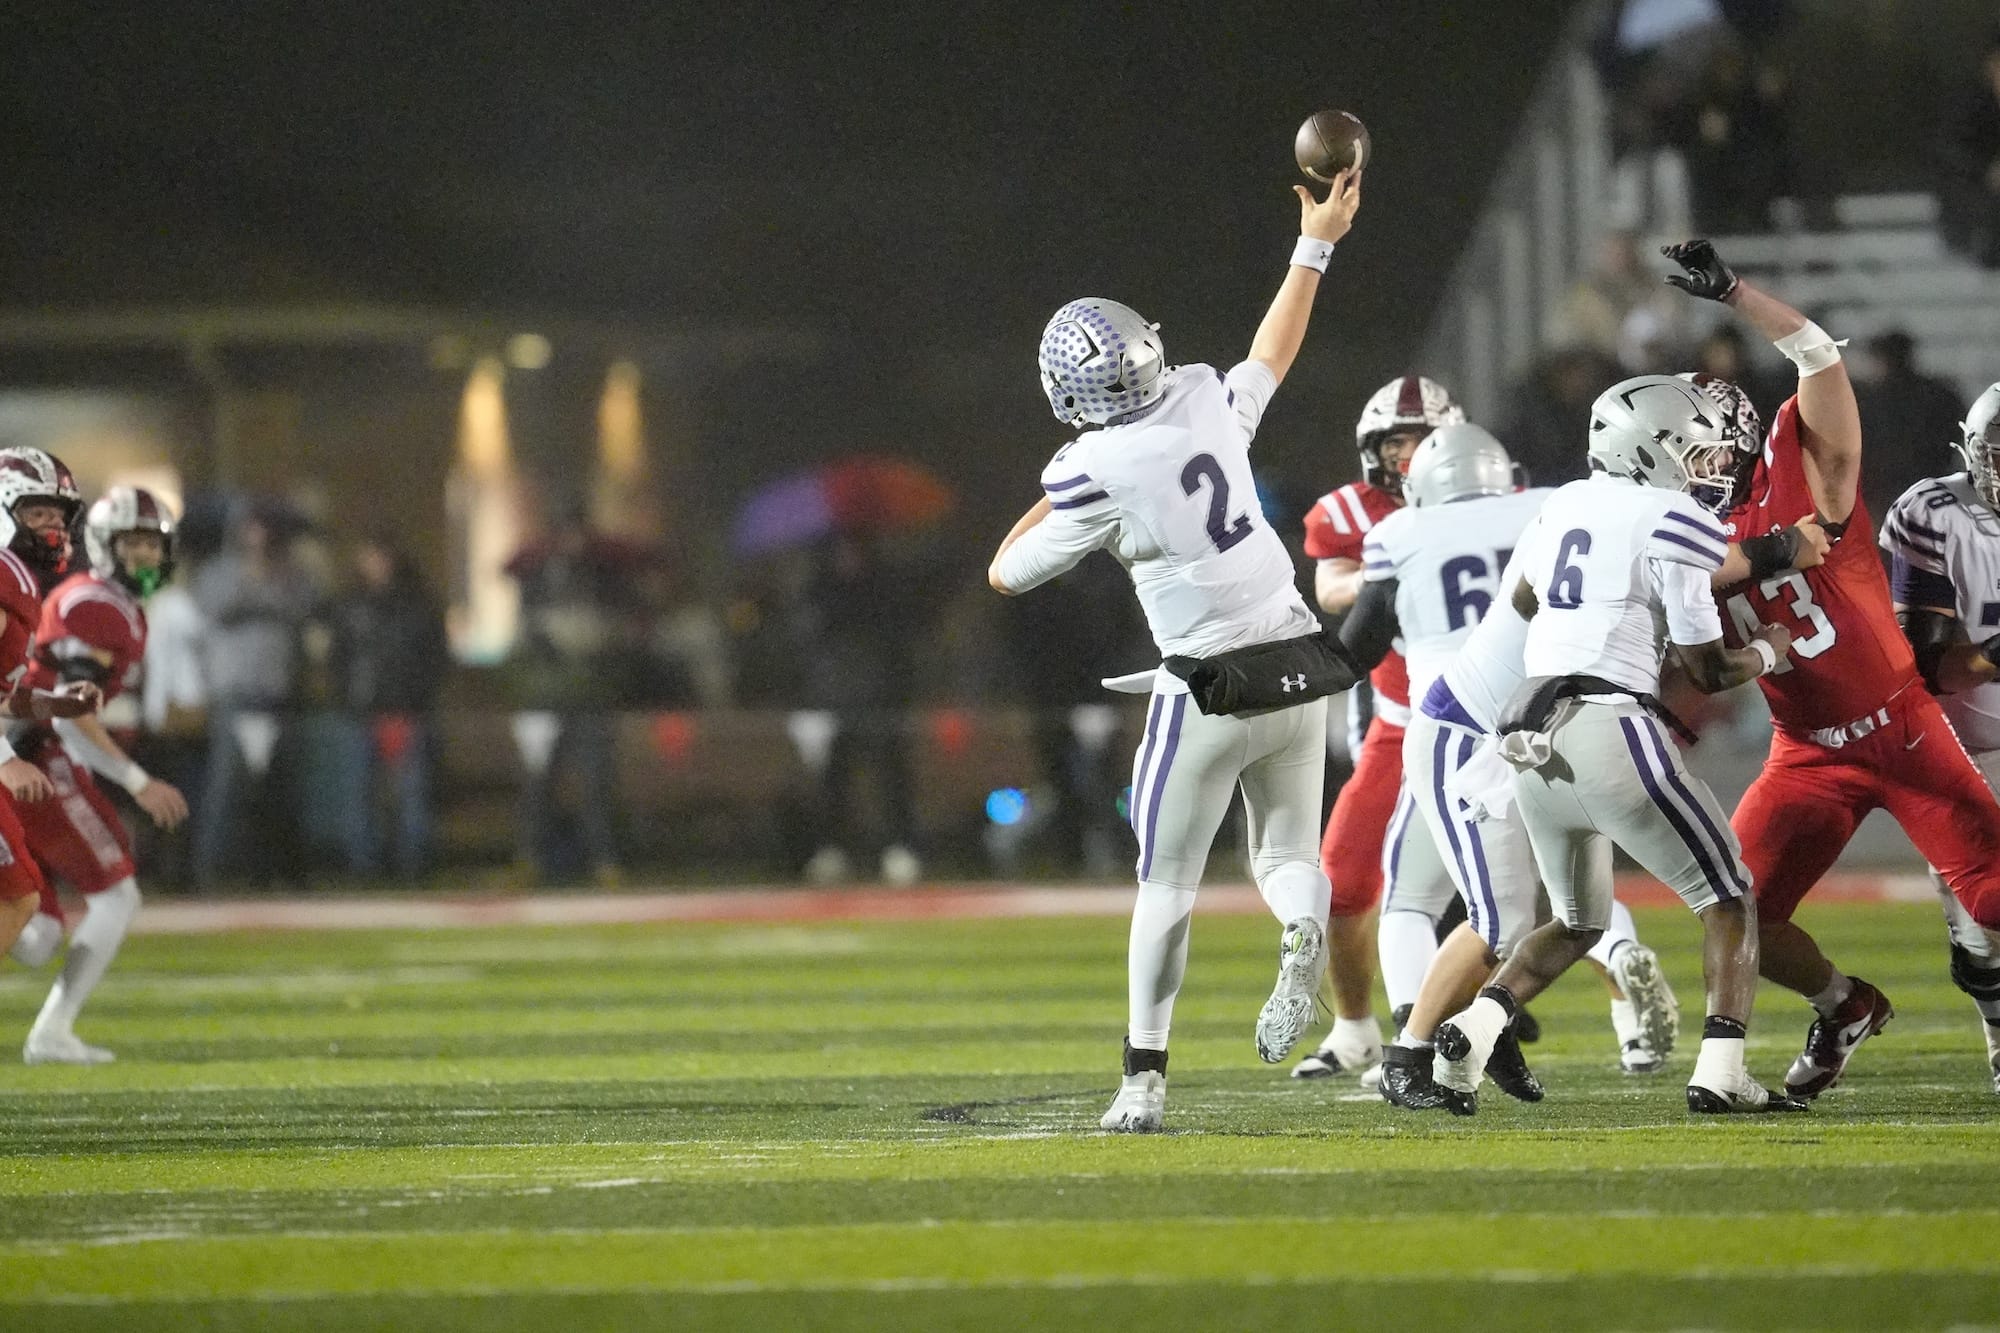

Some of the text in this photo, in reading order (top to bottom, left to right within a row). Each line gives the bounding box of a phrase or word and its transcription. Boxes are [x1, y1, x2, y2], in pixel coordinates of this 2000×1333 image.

[1180, 452, 1253, 554] 2
[1440, 549, 1514, 633] 6
[1547, 527, 1592, 610] 6
